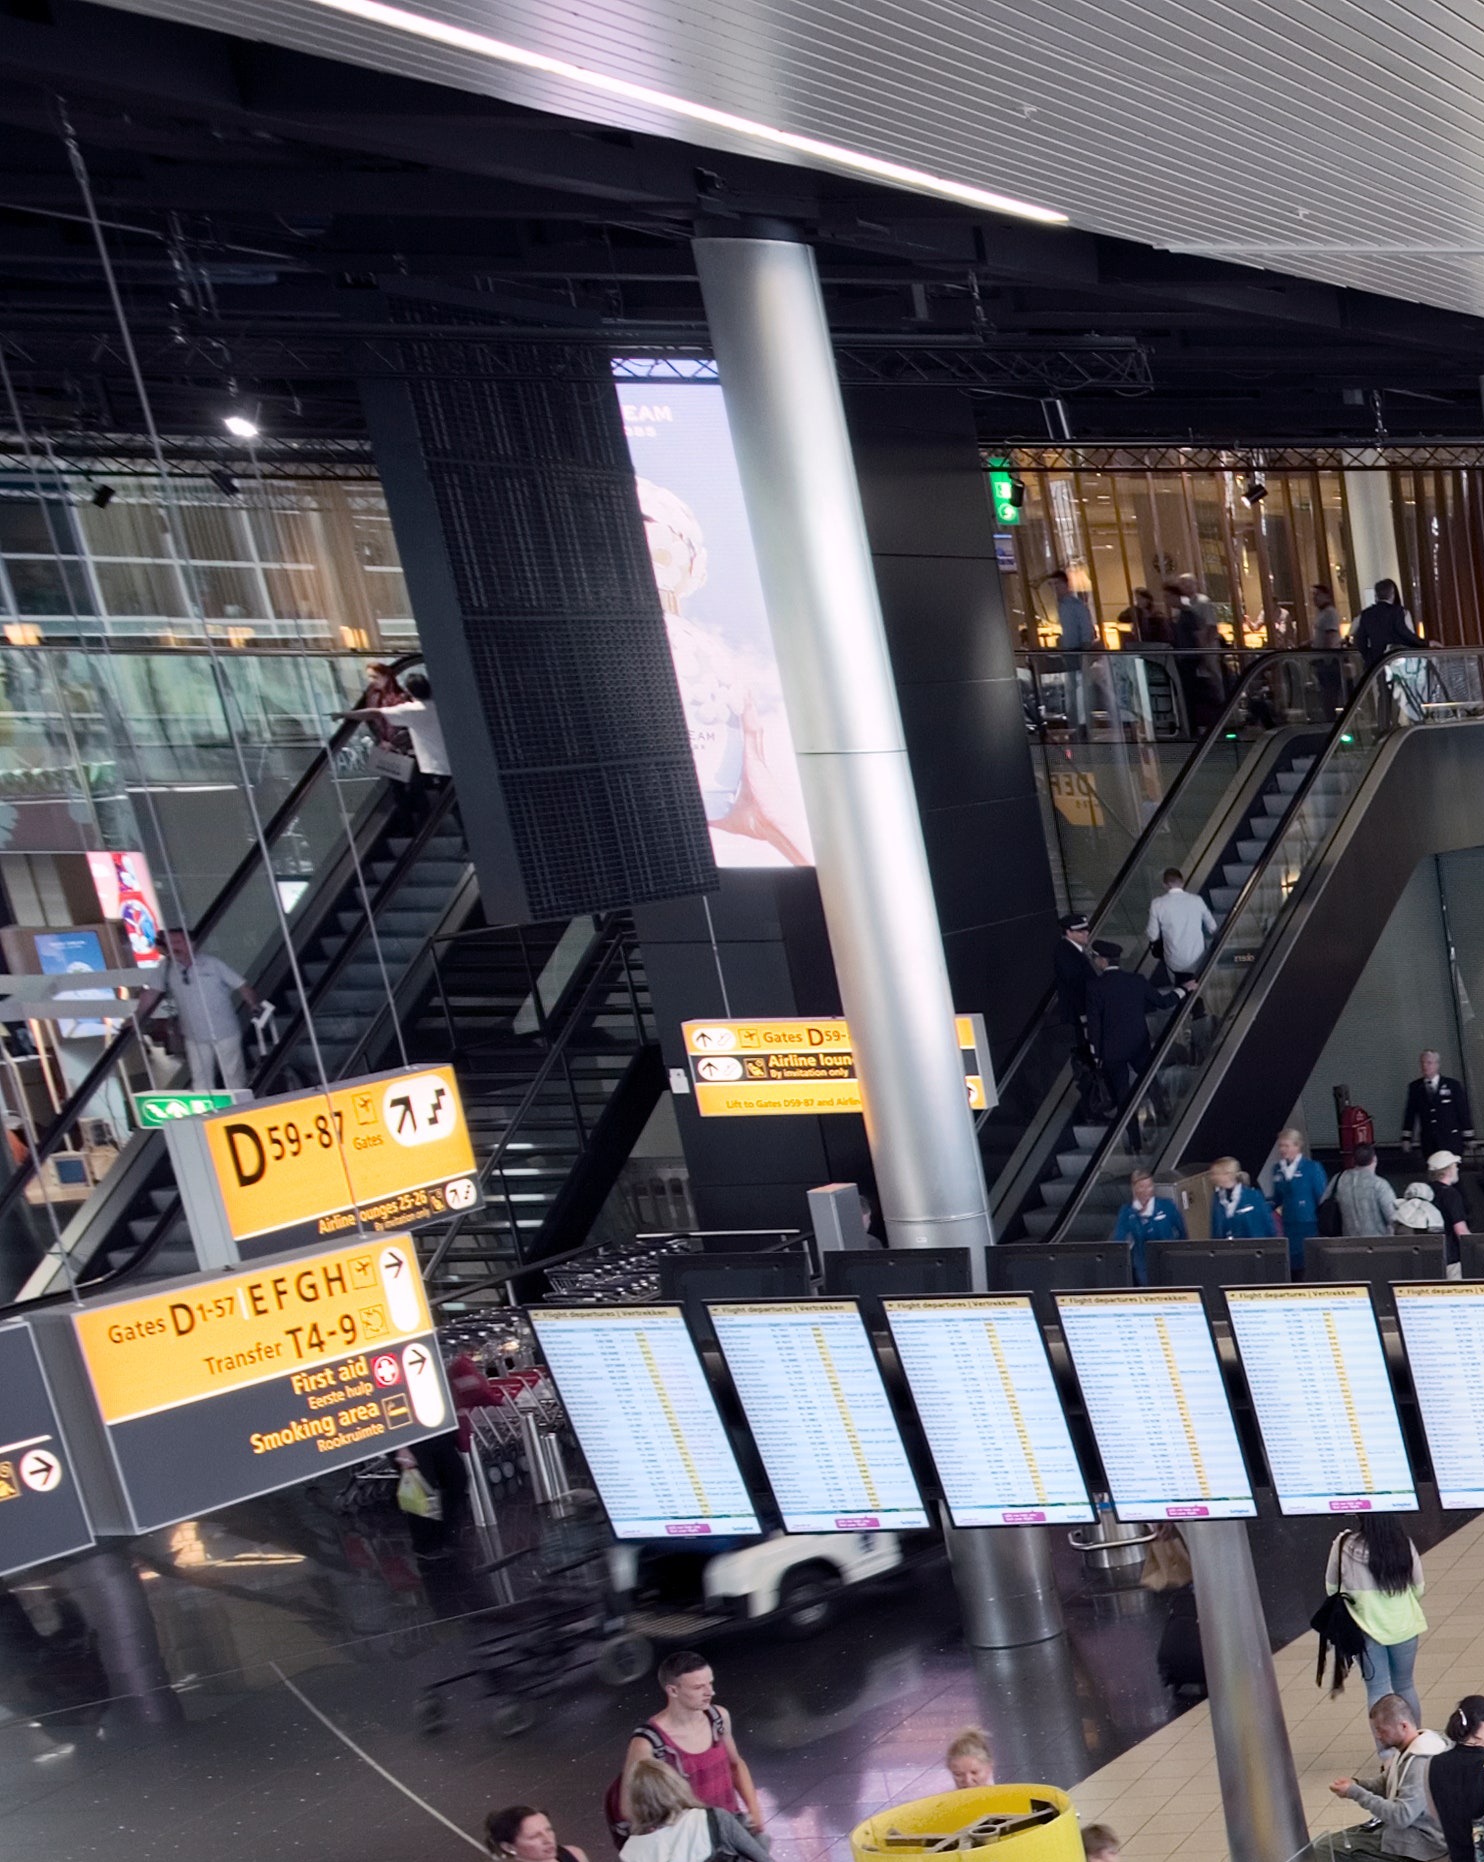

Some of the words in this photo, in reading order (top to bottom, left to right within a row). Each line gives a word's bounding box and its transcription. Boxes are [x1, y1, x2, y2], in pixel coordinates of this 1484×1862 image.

[622, 405, 673, 422] EAM
[763, 1031, 803, 1044] Gates
[768, 1054, 817, 1067] Airline
[820, 1053, 853, 1070] loun
[770, 1068, 781, 1079] By
[783, 1067, 827, 1078] invitation
[828, 1067, 849, 1079] only
[726, 1098, 742, 1109] Lift
[743, 1099, 755, 1108] to
[755, 1098, 782, 1109] Gates
[783, 1098, 814, 1108] D59-87
[817, 1097, 834, 1107] and
[353, 1133, 384, 1150] Gates
[318, 1210, 356, 1234] Airline
[356, 1199, 398, 1223] ounges
[108, 1316, 166, 1344] Gates
[205, 1340, 283, 1375] Transfer
[285, 1314, 358, 1359] T4-9
[290, 1365, 336, 1396] First
[339, 1355, 369, 1382] aid
[308, 1388, 345, 1410] Eerste
[346, 1380, 374, 1402] hulp
[250, 1415, 336, 1454] Smoking
[339, 1402, 380, 1428] area
[317, 1421, 385, 1453] Rookruimte
